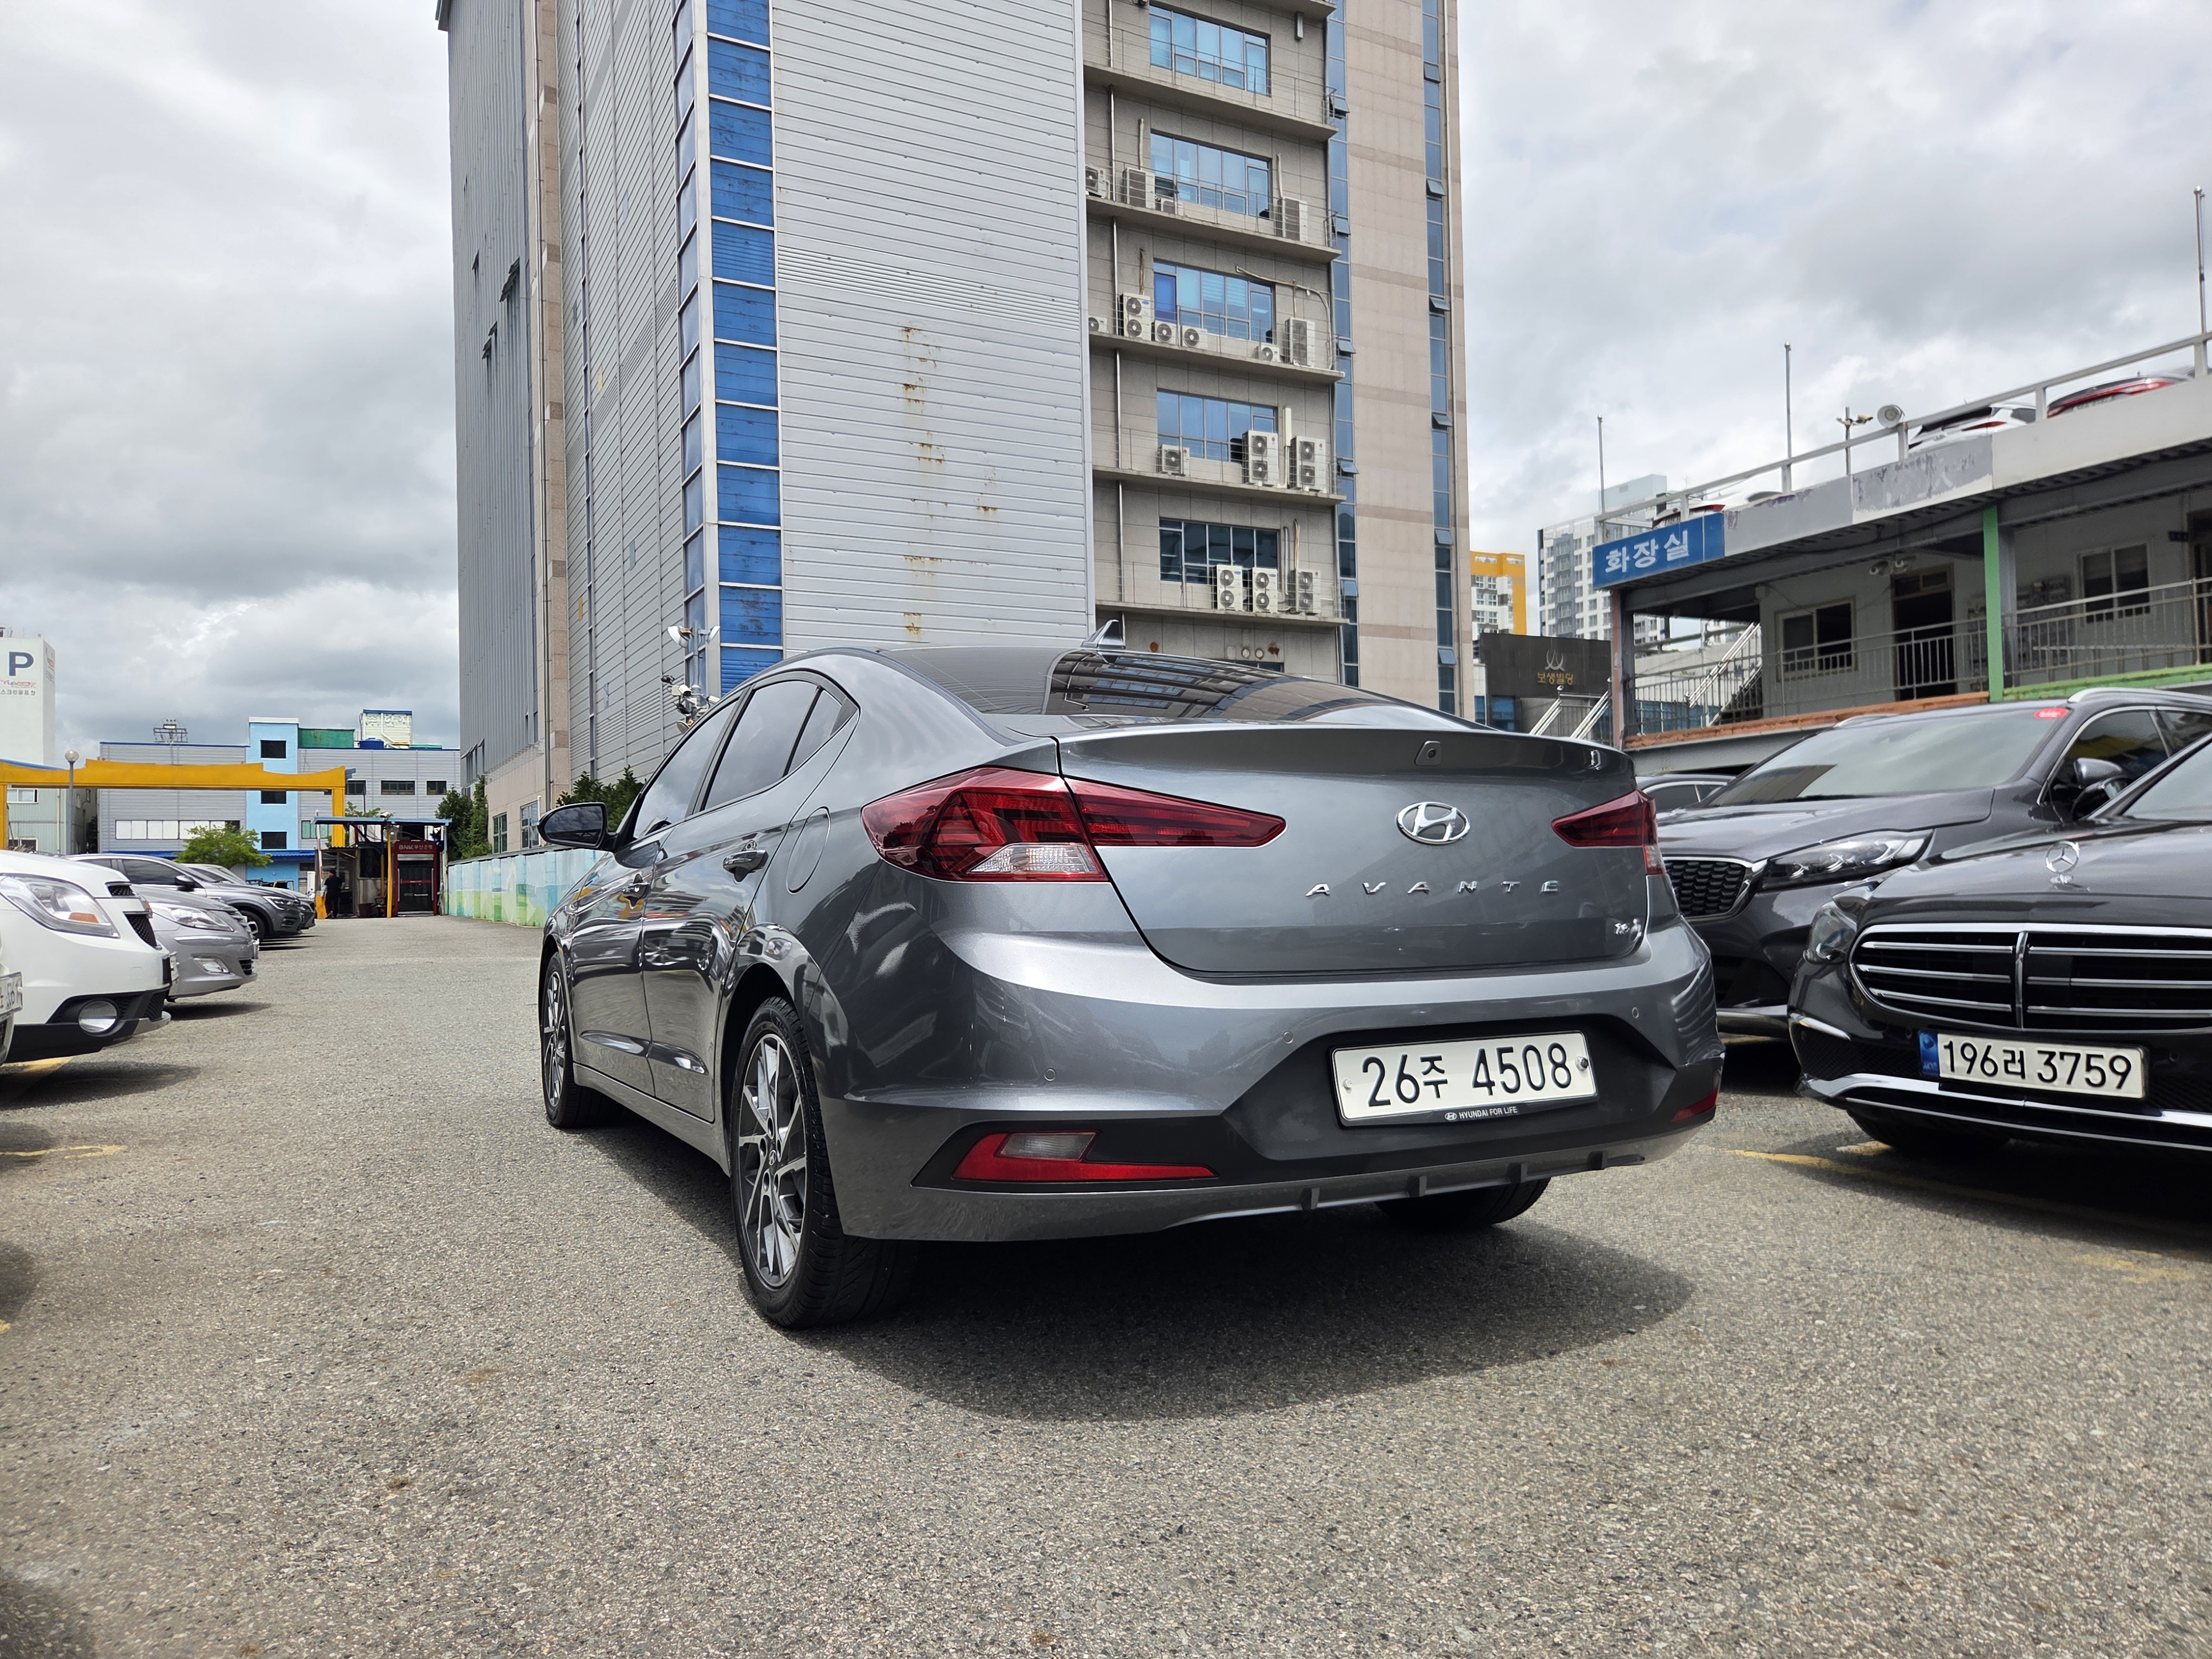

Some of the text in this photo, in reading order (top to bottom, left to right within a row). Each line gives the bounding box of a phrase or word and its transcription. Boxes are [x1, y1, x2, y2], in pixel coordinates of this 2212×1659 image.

[1605, 529, 1689, 573] 화장실
[9, 651, 34, 676] P
[1537, 672, 1574, 685] 보생빌딩
[1305, 880, 1559, 896] AVANTE
[1362, 1042, 1572, 1107] 26주 4508
[1943, 1040, 2132, 1089] 196러 3759
[1458, 1109, 1488, 1119] HYUNDAI
